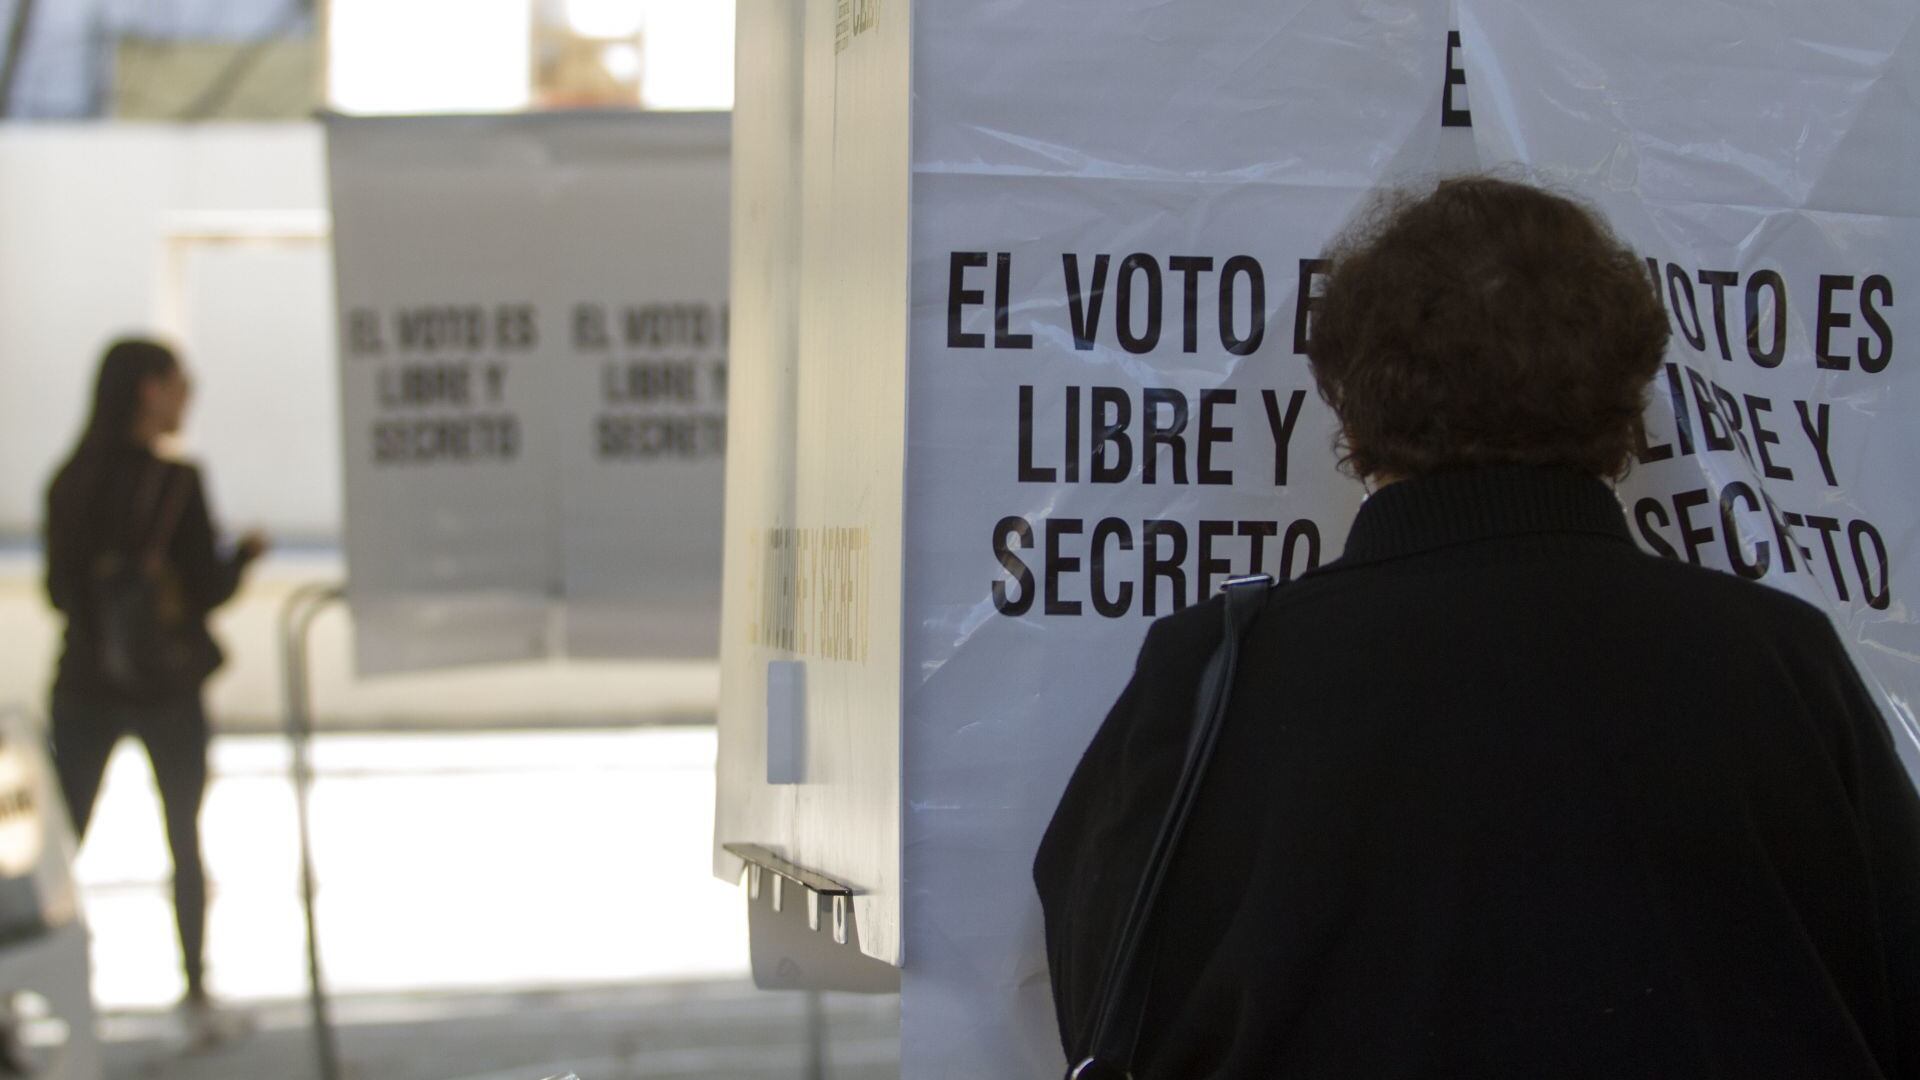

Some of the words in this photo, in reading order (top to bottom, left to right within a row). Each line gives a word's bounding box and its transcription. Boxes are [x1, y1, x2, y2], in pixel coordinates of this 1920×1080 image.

[947, 251, 1033, 349] EL
[1062, 252, 1266, 356] VOTO
[1292, 258, 1333, 354] E
[1815, 274, 1894, 374] ES
[1018, 385, 1237, 486] LIBRE
[1261, 389, 1307, 487] Y
[1793, 400, 1839, 487] Y
[991, 516, 1321, 618] SECRETO
